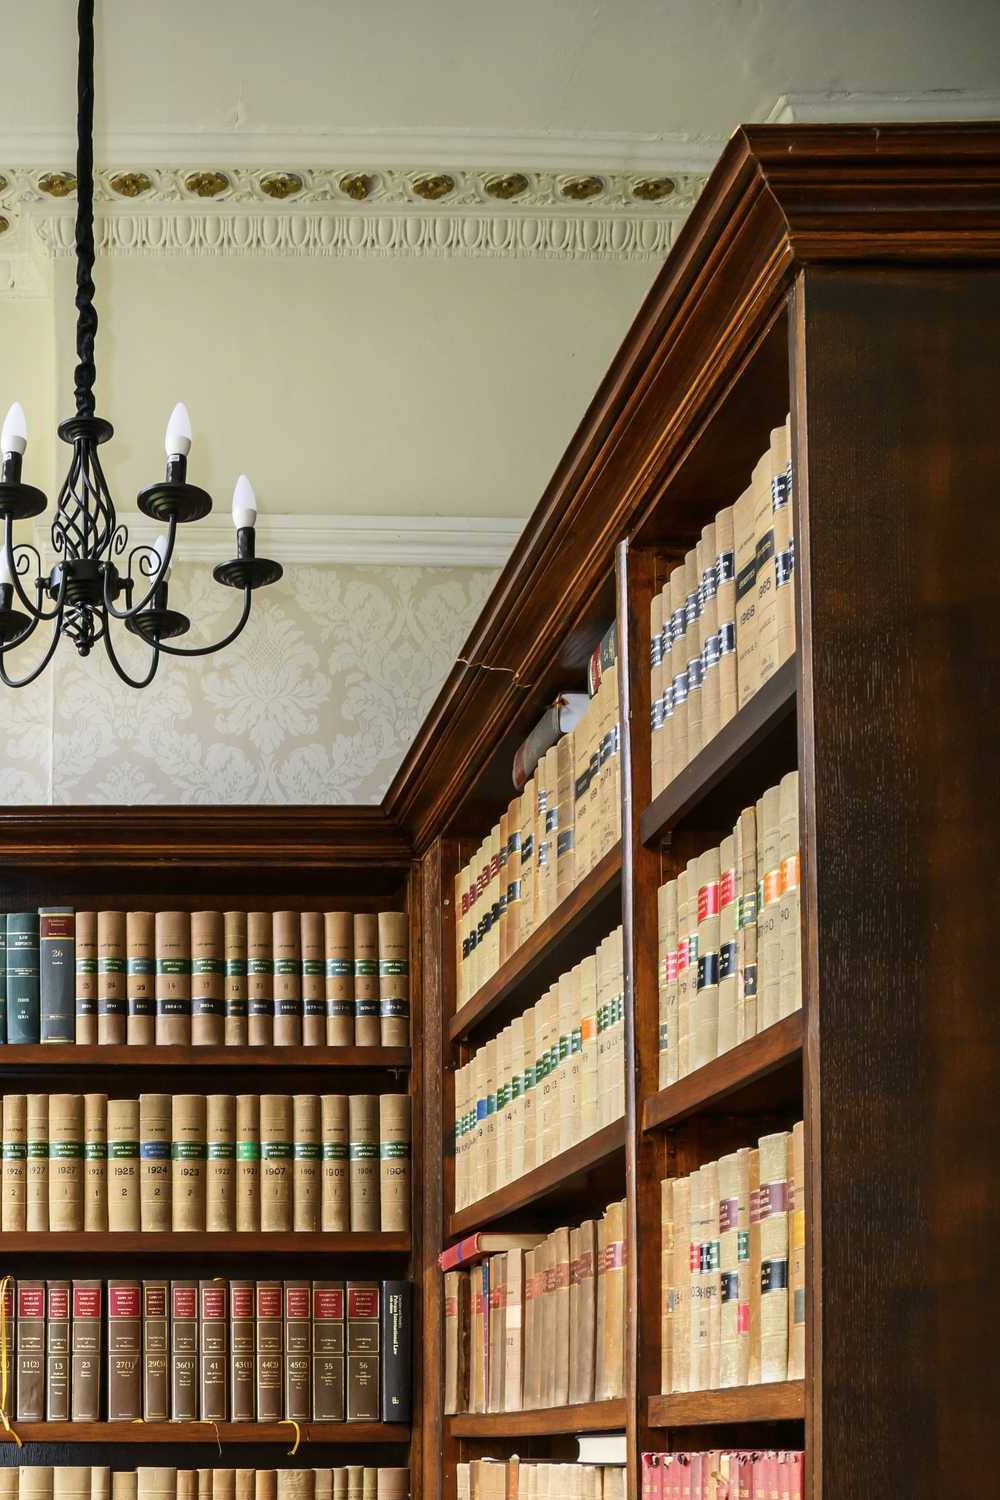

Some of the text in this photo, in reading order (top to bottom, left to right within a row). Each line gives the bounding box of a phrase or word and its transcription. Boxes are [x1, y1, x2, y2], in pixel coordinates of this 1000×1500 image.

[52, 950, 62, 958] 26
[6, 1168, 23, 1176] 1926
[29, 1166, 46, 1175] 1927
[58, 1166, 77, 1175] 1927
[114, 1167, 135, 1176] 1925
[147, 1166, 168, 1174] 1924
[180, 1168, 200, 1177] 1923
[265, 1168, 287, 1176] 1907
[386, 1167, 406, 1175] 1904
[121, 1188, 127, 1196] 2
[154, 1188, 160, 1196] 2
[361, 1188, 367, 1196] 2
[22, 1361, 40, 1369] 11(2)
[55, 1362, 63, 1370] 13
[176, 1361, 195, 1369] 36(1)
[261, 1361, 279, 1369] 44(2)
[290, 1361, 308, 1369] 45(2)
[324, 1362, 333, 1370] 55
[359, 1361, 368, 1369] 56
